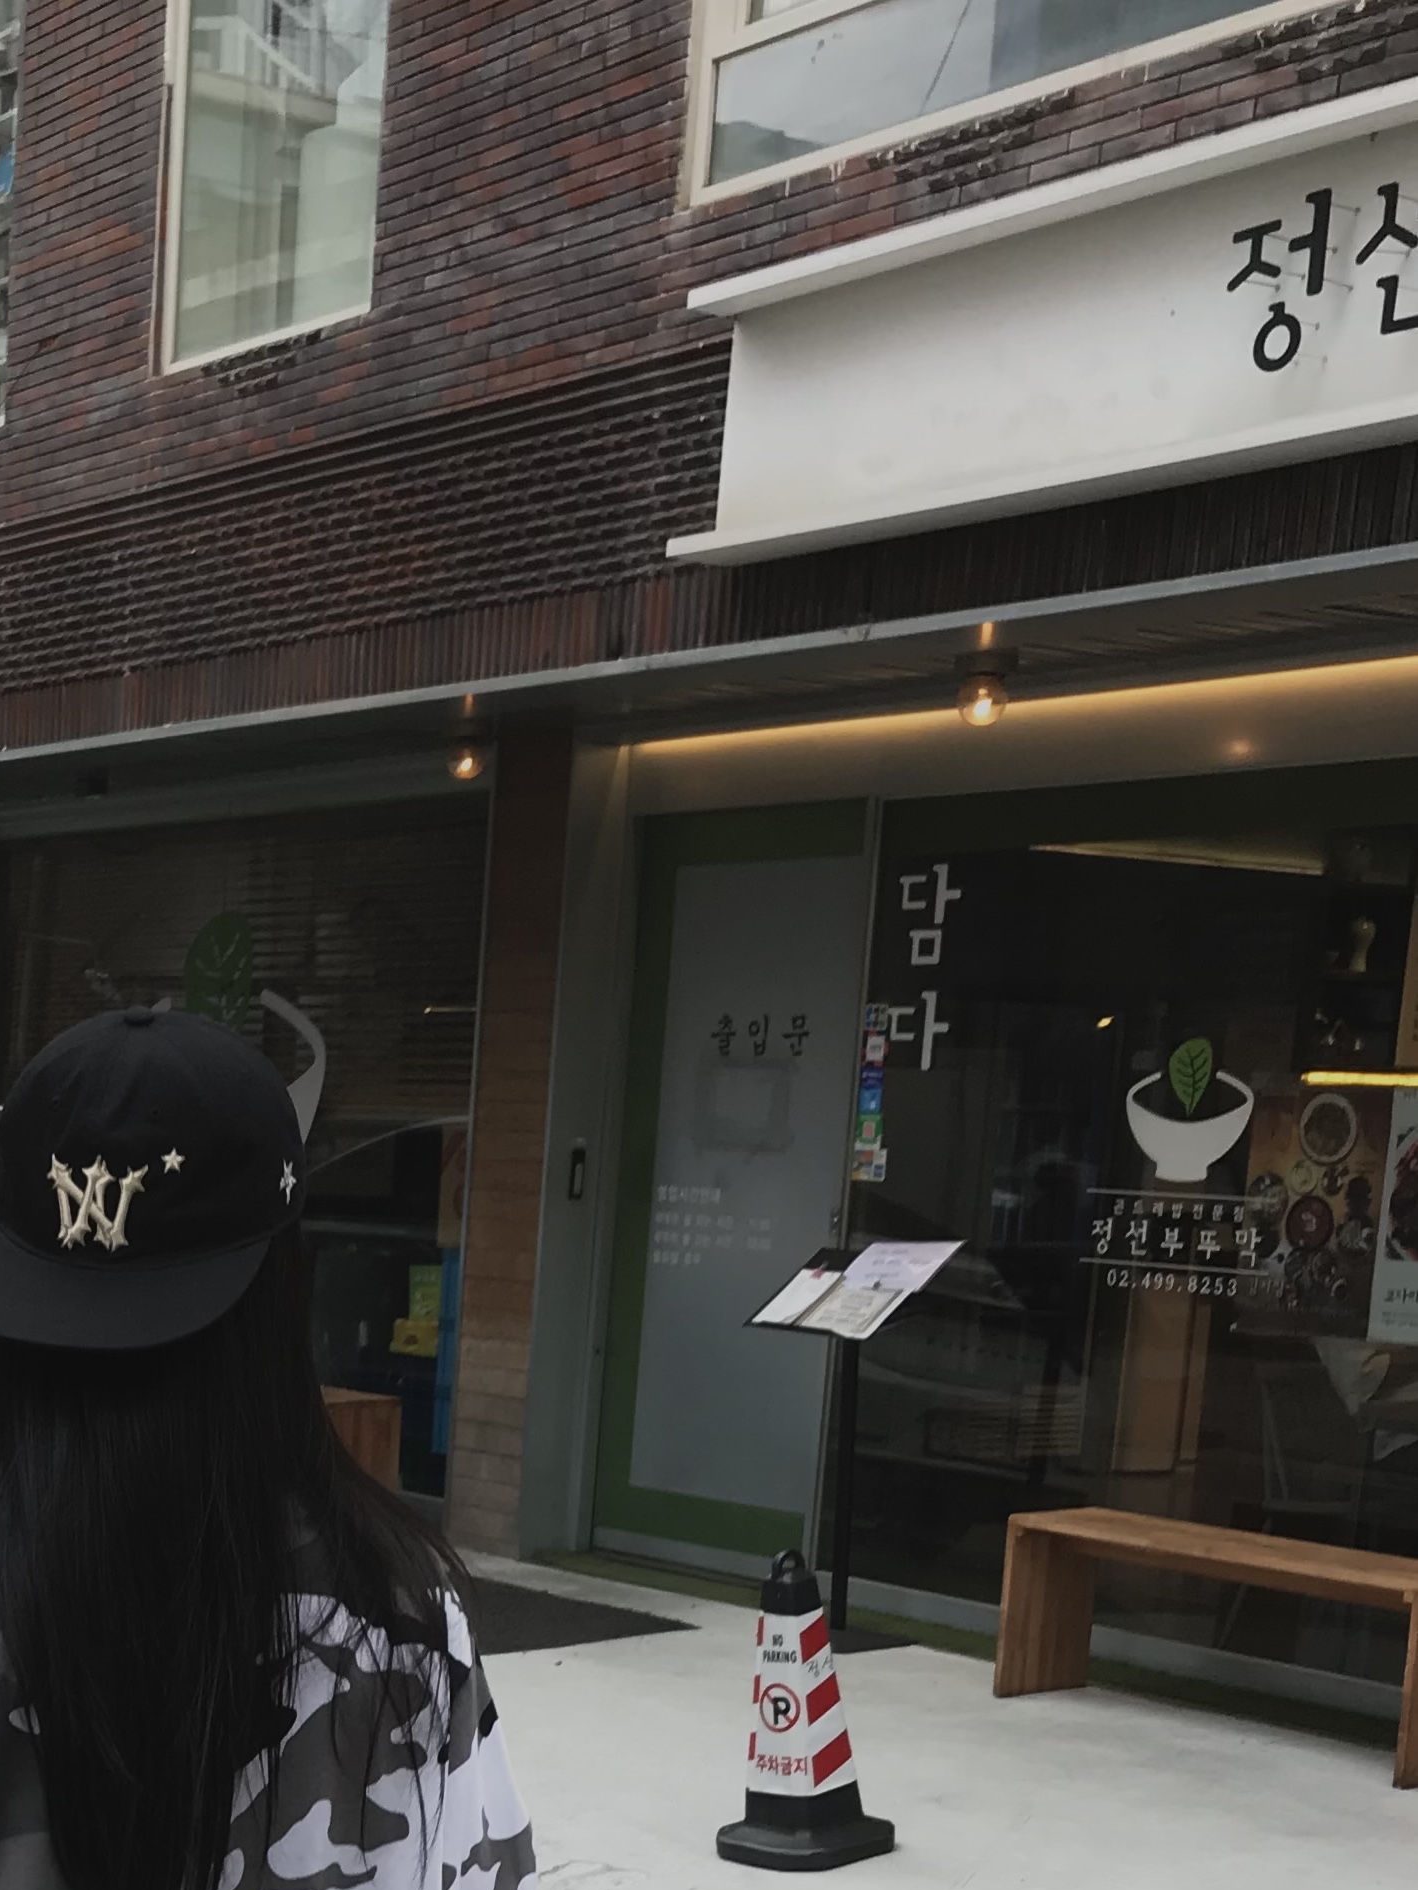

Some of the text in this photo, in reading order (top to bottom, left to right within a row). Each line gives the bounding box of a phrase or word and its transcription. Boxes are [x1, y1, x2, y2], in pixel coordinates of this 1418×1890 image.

[887, 863, 962, 1072] 담다
[710, 1013, 811, 1057] 출입문
[1090, 1216, 1266, 1269] 정선부뚜막
[772, 1634, 784, 1647] NO
[762, 1650, 798, 1665] PARKING
[755, 1754, 809, 1777] 주차금지
